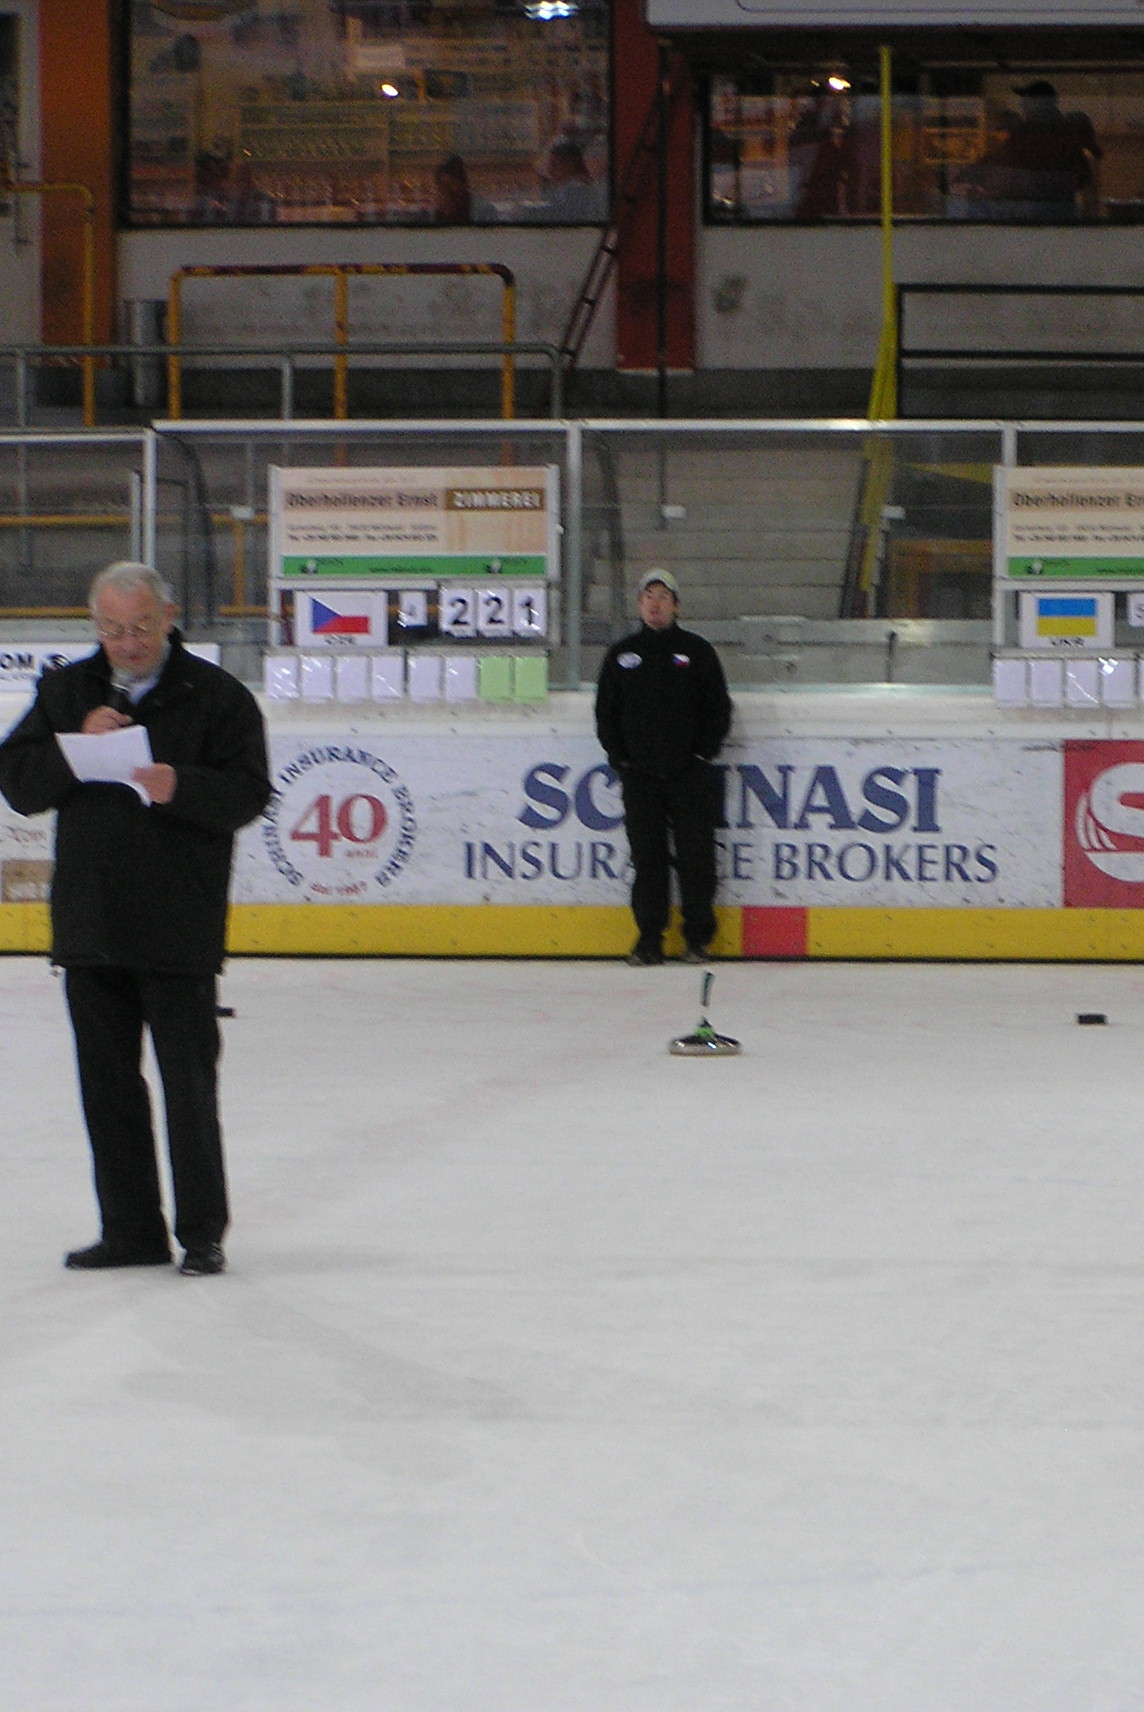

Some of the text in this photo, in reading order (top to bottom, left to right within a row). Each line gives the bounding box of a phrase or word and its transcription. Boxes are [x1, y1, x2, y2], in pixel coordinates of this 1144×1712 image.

[397, 491, 438, 508] Ernst
[453, 491, 541, 508] ZIMMEREI
[450, 597, 541, 627] 221
[278, 746, 398, 784] INSURANCE
[290, 794, 388, 858] 40
[464, 841, 1000, 884] INSURE BROKERS
